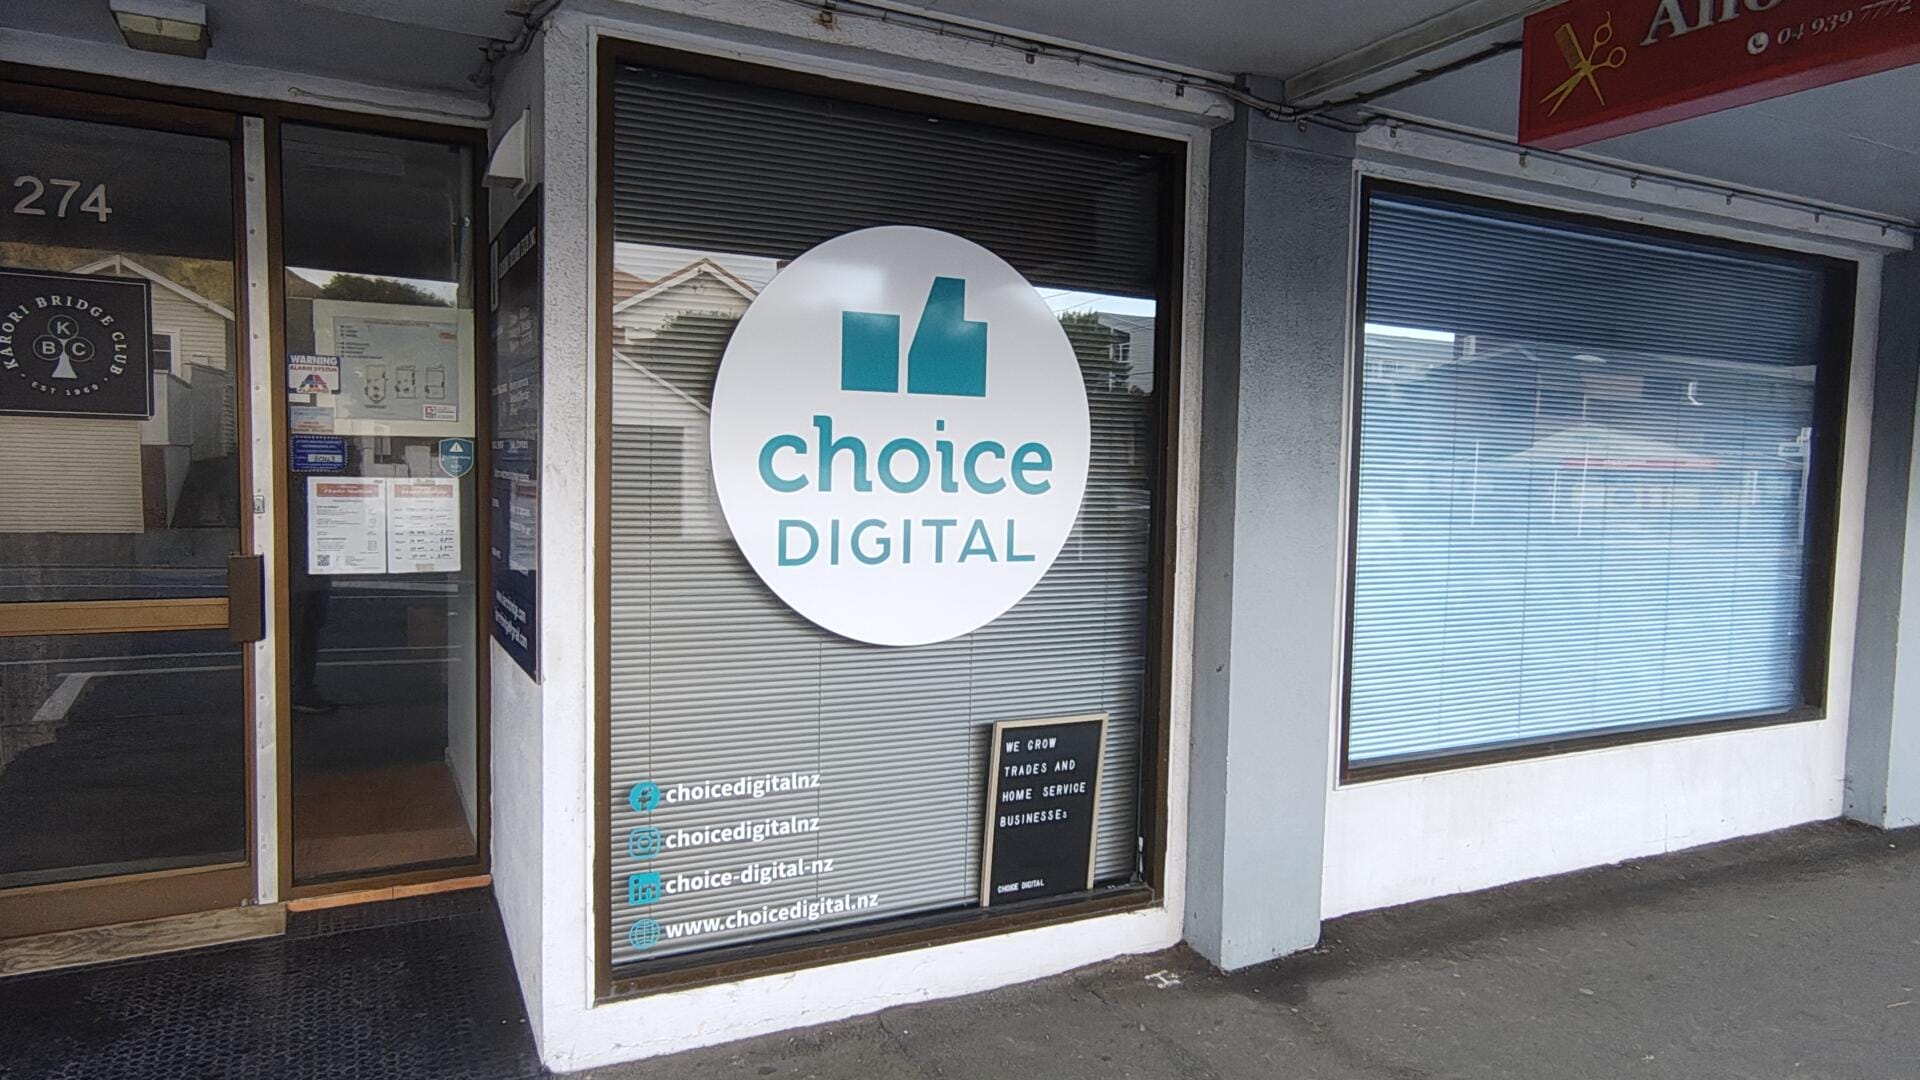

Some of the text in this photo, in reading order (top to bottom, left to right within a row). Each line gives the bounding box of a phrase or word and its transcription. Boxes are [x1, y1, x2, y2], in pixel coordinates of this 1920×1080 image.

[13, 175, 113, 222] 274
[0, 295, 128, 376] KARORI BRIDGE CLUB
[56, 321, 71, 336] K
[41, 340, 87, 357] B C
[290, 354, 338, 366] WARNING
[758, 415, 1053, 495] choice
[777, 518, 1036, 567] DIGITAL
[1005, 737, 1057, 753] WE GROW
[1004, 759, 1076, 778] TRADES AND
[665, 772, 821, 803] choicedigitalnz
[1002, 781, 1087, 803] HOME SERVICE
[665, 816, 820, 849] choicedigitalnz
[665, 858, 834, 894] choice-digital-nz
[997, 878, 1045, 894] CHOICE DIGITAL
[665, 892, 879, 939] www.choicedigital.nz
